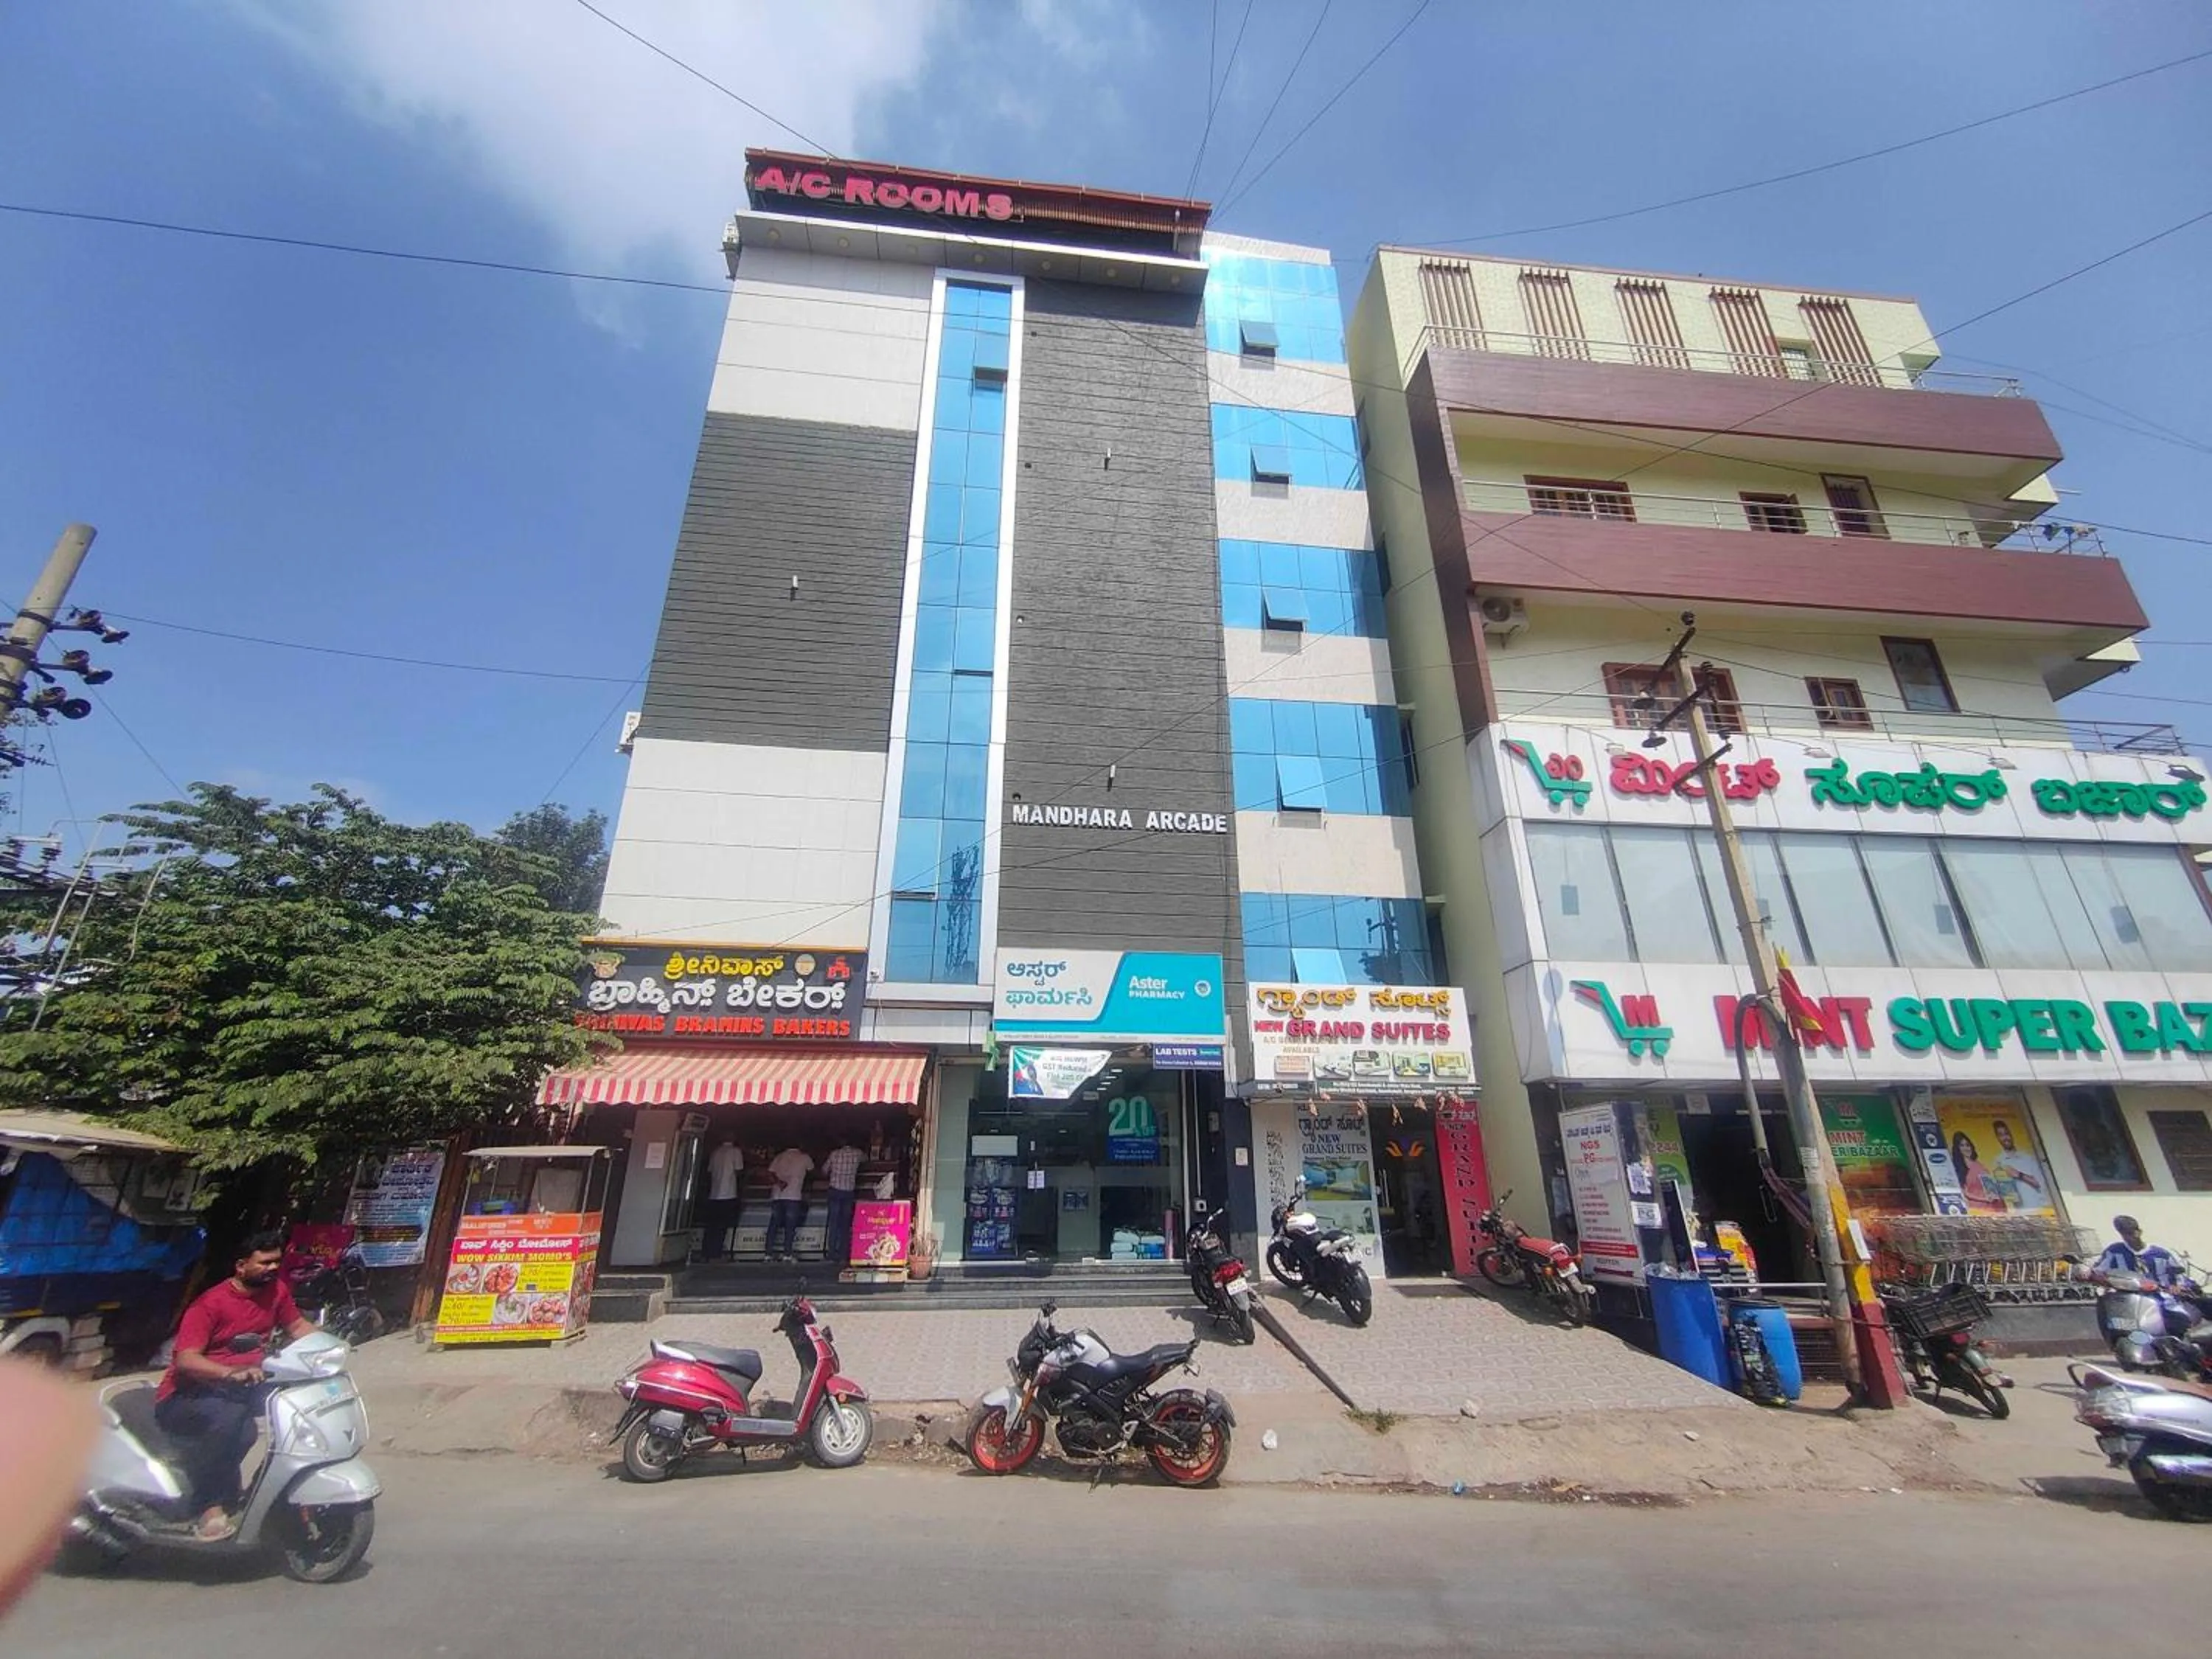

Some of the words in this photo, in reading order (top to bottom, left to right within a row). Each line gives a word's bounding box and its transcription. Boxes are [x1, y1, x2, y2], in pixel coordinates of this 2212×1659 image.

[754, 166, 833, 199] A/C
[844, 175, 1014, 221] ROOMS
[1012, 804, 1133, 829] MANDHARA
[1145, 811, 1228, 833] ARCADE
[1006, 960, 1067, 986] ಆಸ್ಟರ್
[1129, 975, 1168, 990] Aster
[1128, 990, 1186, 999] PHARMACY
[1620, 995, 1660, 1026] M
[674, 1016, 765, 1034] BRAMINS
[772, 1019, 850, 1036] BAKERS
[1253, 1020, 1284, 1033] NEW
[1286, 1020, 1366, 1039] GRAND
[1371, 1022, 1452, 1040] SUITES
[1886, 996, 2107, 1052] SUPER
[1108, 1096, 1148, 1136] 20
[1318, 1134, 1340, 1143] NEW
[1302, 1144, 1334, 1154] GRAND
[1335, 1144, 1368, 1154] SUITES
[456, 1253, 484, 1262] WOW
